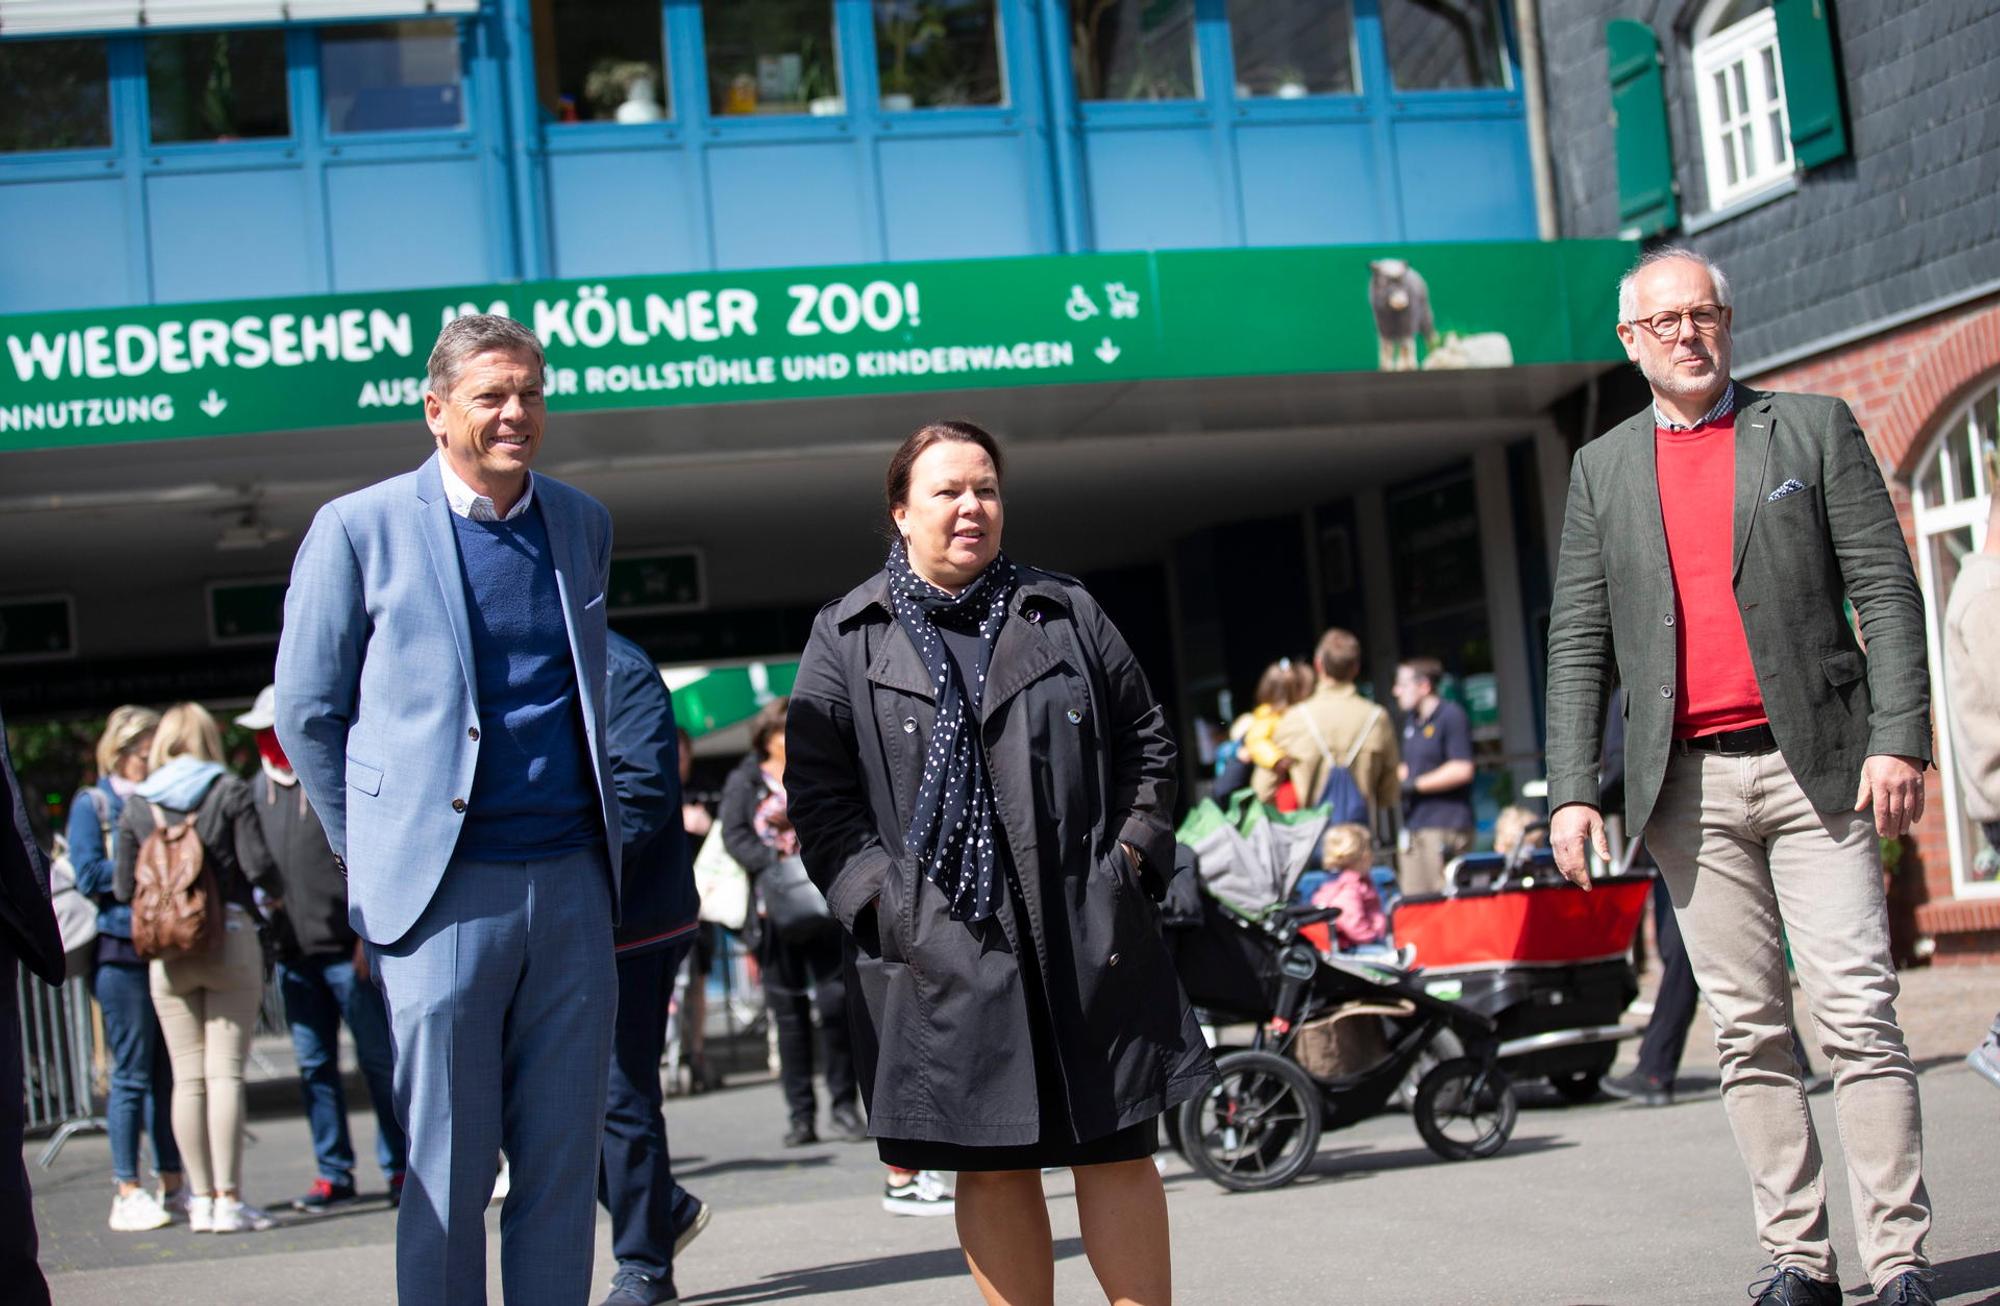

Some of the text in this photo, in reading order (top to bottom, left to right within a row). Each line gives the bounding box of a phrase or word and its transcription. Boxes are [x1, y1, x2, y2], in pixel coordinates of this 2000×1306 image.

[7, 308, 413, 381] WIEDERSEHEN
[533, 285, 758, 349] KÖLNER
[787, 281, 920, 336] ZOO!
[585, 356, 775, 394] ROLLSTÜHLE
[783, 353, 850, 383] UND
[856, 342, 1073, 377] KINDERWAGEN
[0, 393, 174, 432] NNUTZUNG
